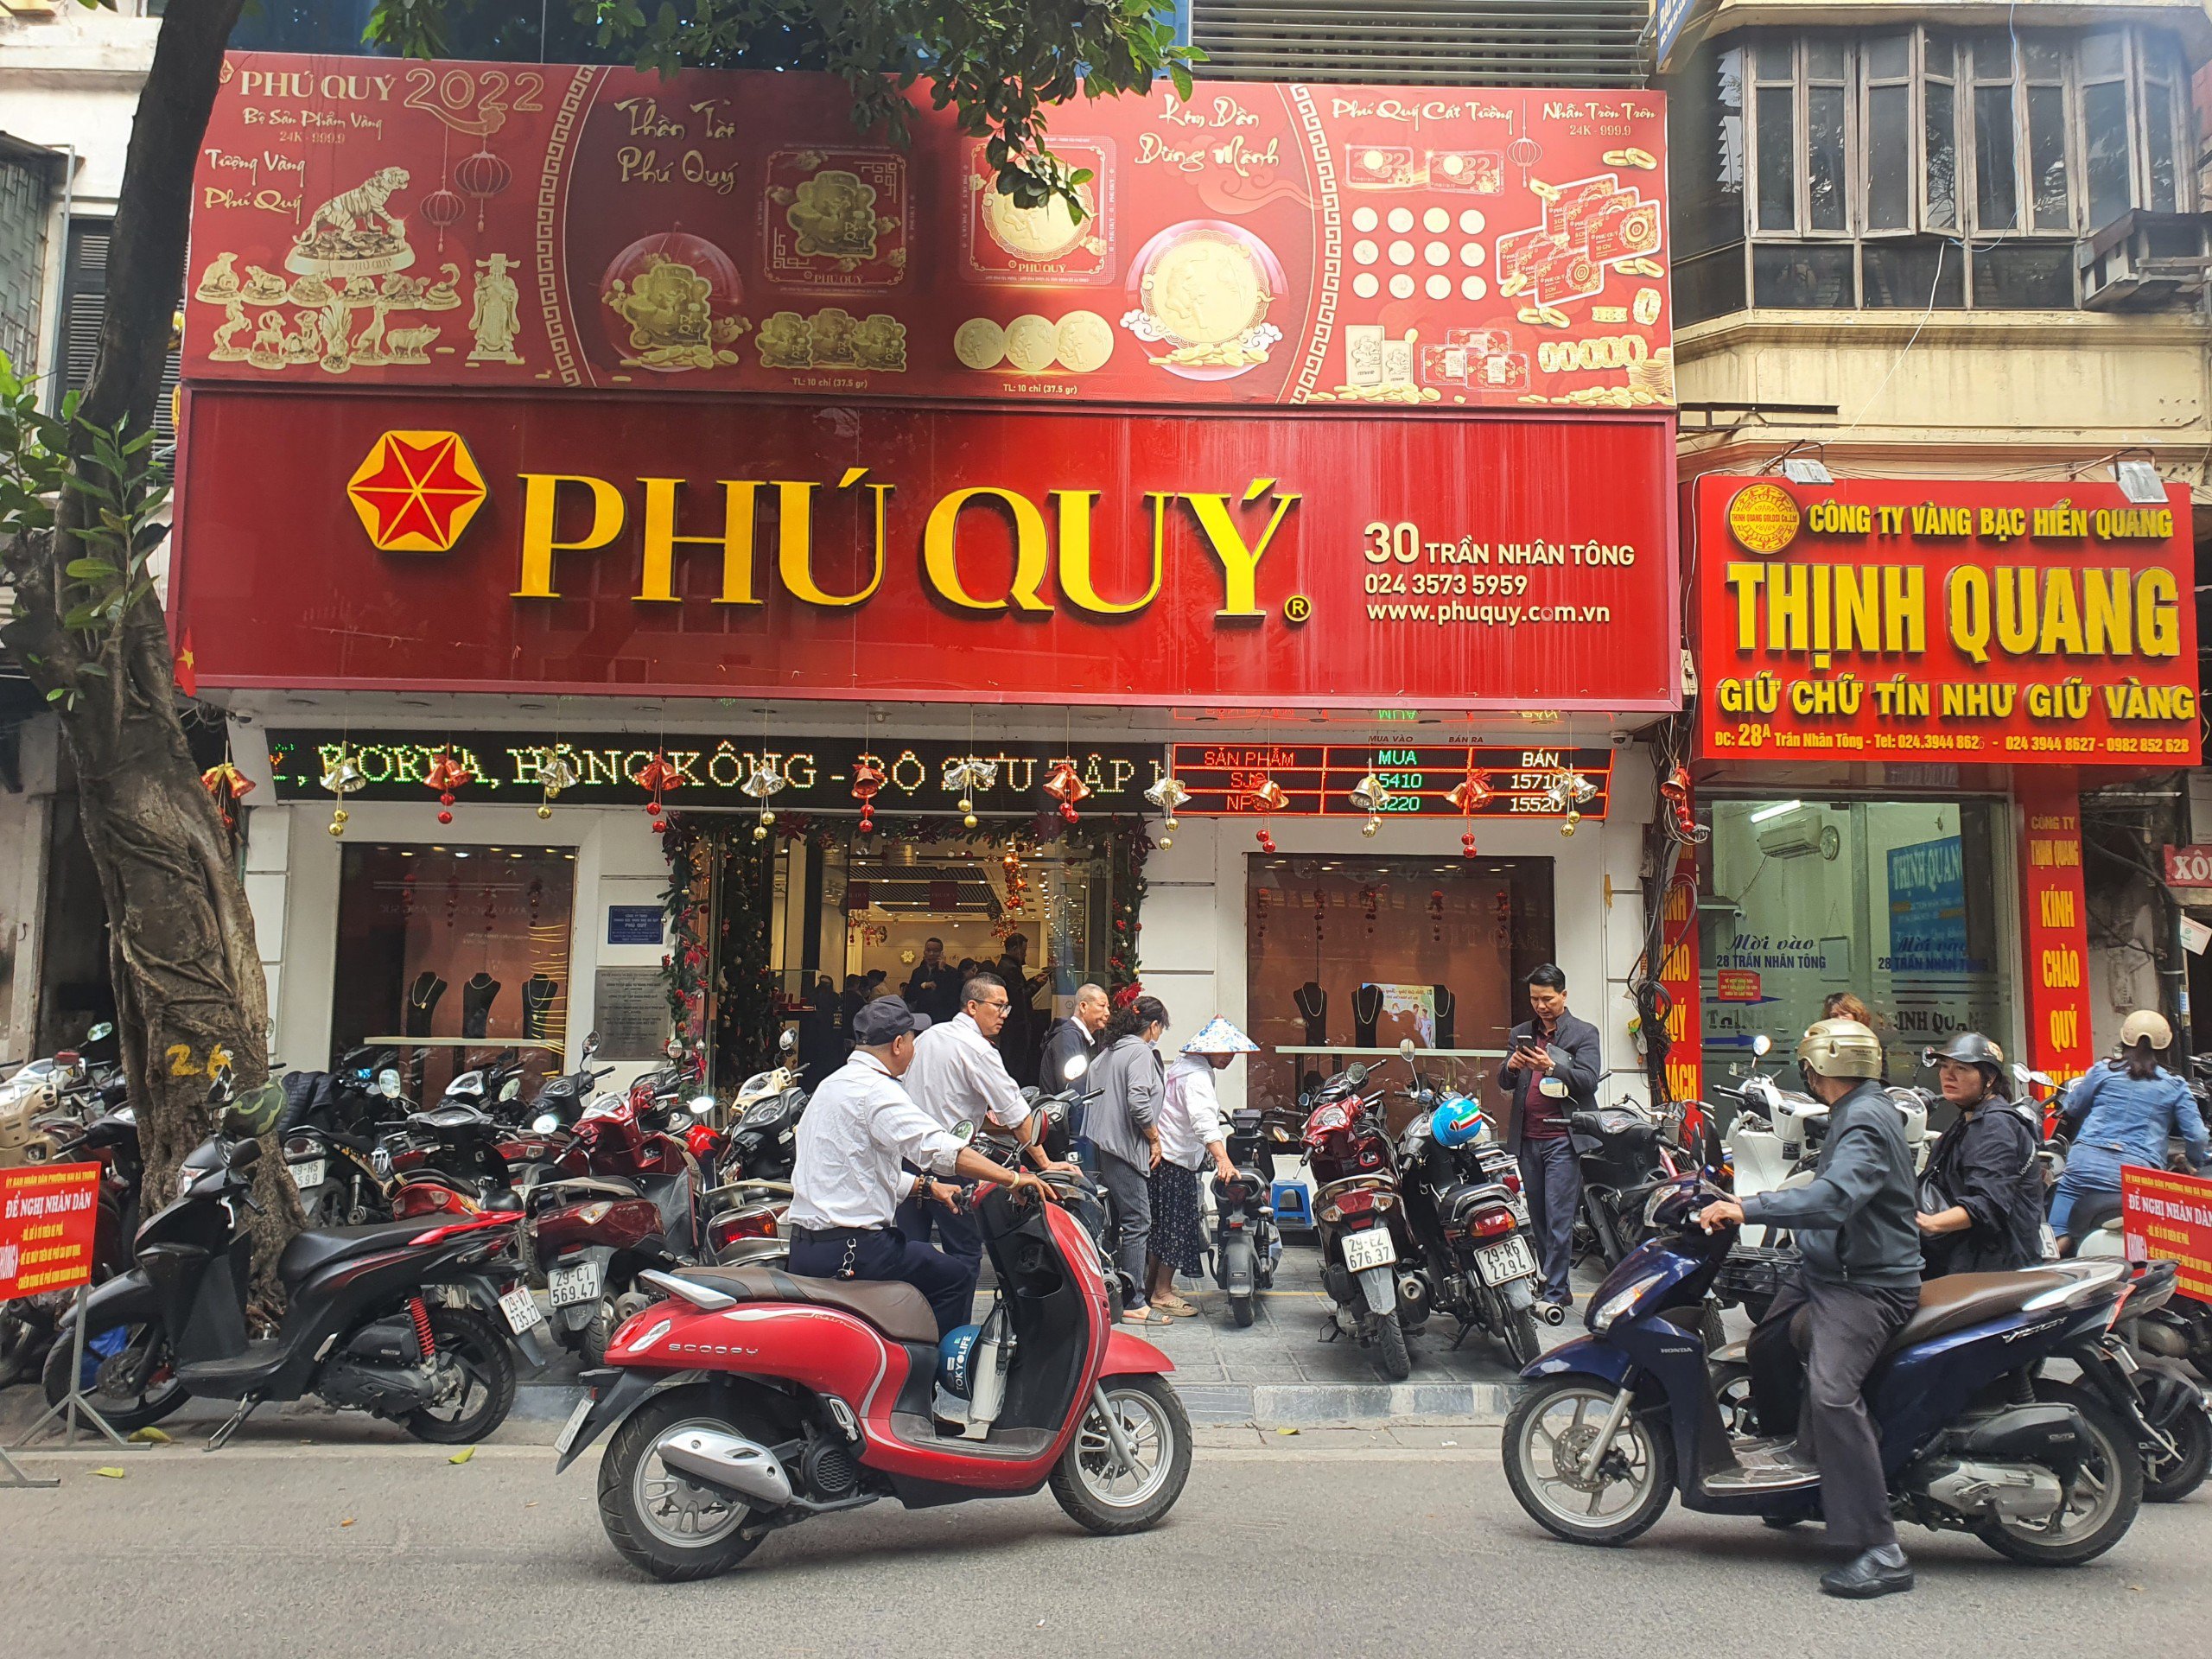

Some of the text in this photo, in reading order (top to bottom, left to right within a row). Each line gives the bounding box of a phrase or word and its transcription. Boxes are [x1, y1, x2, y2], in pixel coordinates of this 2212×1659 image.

[239, 68, 544, 112] PHÚ QUÝ 2022
[243, 107, 384, 141] Bộ Sản Phẩm Vàng
[614, 98, 735, 140] Thần Tài
[1332, 98, 1375, 118] Phú
[1376, 99, 1421, 132] Quý
[1422, 101, 1462, 120] Cát
[1542, 101, 1585, 121] Nhẫn
[1585, 102, 1621, 121] Tròn
[279, 130, 302, 143] 24K
[1569, 125, 1631, 137] 24K 999.9
[264, 150, 306, 188] Vàng
[617, 145, 739, 195] Phú Quý
[204, 187, 303, 225] Phú Quý
[792, 377, 806, 386] TL:
[807, 378, 817, 387] 10
[833, 378, 854, 388] (37.5
[855, 379, 868, 390] gr)
[1003, 384, 1016, 392] TL:
[1018, 384, 1027, 392] 10
[1043, 385, 1064, 394] (37.5
[1065, 385, 1078, 396] gr)
[1808, 499, 2175, 543] CÔNG TY VÀNG BẠC HIỂN QUANG
[510, 467, 1303, 620] PHÚ QUÝ
[1363, 521, 1635, 567] 30 TRẦN NHÂN TÔNG
[1364, 572, 1529, 596] 024 3573 5959
[1366, 600, 1611, 627] www.phuquy.com.vn
[1726, 561, 2181, 671] THỊNH QUANG
[1718, 671, 2196, 720] GIỮ CHỮ TÍN NHƯ GIỮ VÀNG
[1391, 734, 1414, 743] VÀO
[1714, 731, 1735, 747] ĐC:
[1802, 732, 1834, 748] Nhân
[1835, 733, 1864, 750] Tông
[1874, 734, 1896, 749] Tel:
[1897, 734, 1955, 750] 024.3944
[2005, 735, 2029, 751] 024
[2031, 736, 2063, 752] 3944
[2064, 736, 2096, 752] 8627
[2106, 737, 2139, 753] 0982
[2139, 738, 2164, 753] 852
[1378, 749, 1418, 766] MUA
[1522, 748, 1560, 768] BÁN
[1375, 772, 1423, 789] 5410
[1510, 773, 1563, 790] 15710
[1370, 796, 1421, 812] 220
[1510, 797, 1564, 812] 15520
[2031, 815, 2075, 830] CÔNG TY
[2030, 840, 2079, 869] THỊNH QUANG
[1928, 843, 1963, 893] QUAN
[2040, 884, 2075, 928] KÍNH
[1726, 933, 1814, 951] Mời vào
[1716, 952, 1827, 969] 28 TRẦN NHÂN TÔNG
[1878, 957, 1891, 970] 28
[2042, 944, 2080, 988] CHÀO
[2050, 1003, 2078, 1053] QUÝ
[20, 1196, 44, 1219] NGHỊ
[45, 1189, 71, 1214] NHÂN
[72, 1187, 92, 1211] DÂN
[2142, 1196, 2165, 1221] NGHỊ
[2166, 1199, 2193, 1223] NHÂN
[1349, 1247, 1390, 1270] 676.37
[1484, 1240, 1520, 1266] 29-R6
[556, 1267, 591, 1287] 29-C1
[1491, 1254, 1528, 1281] 2294
[552, 1281, 596, 1306] 569.47
[511, 1306, 540, 1332] 735.27
[668, 1343, 759, 1355] SCOOPY
[955, 1335, 972, 1391] TOKYOLIFE
